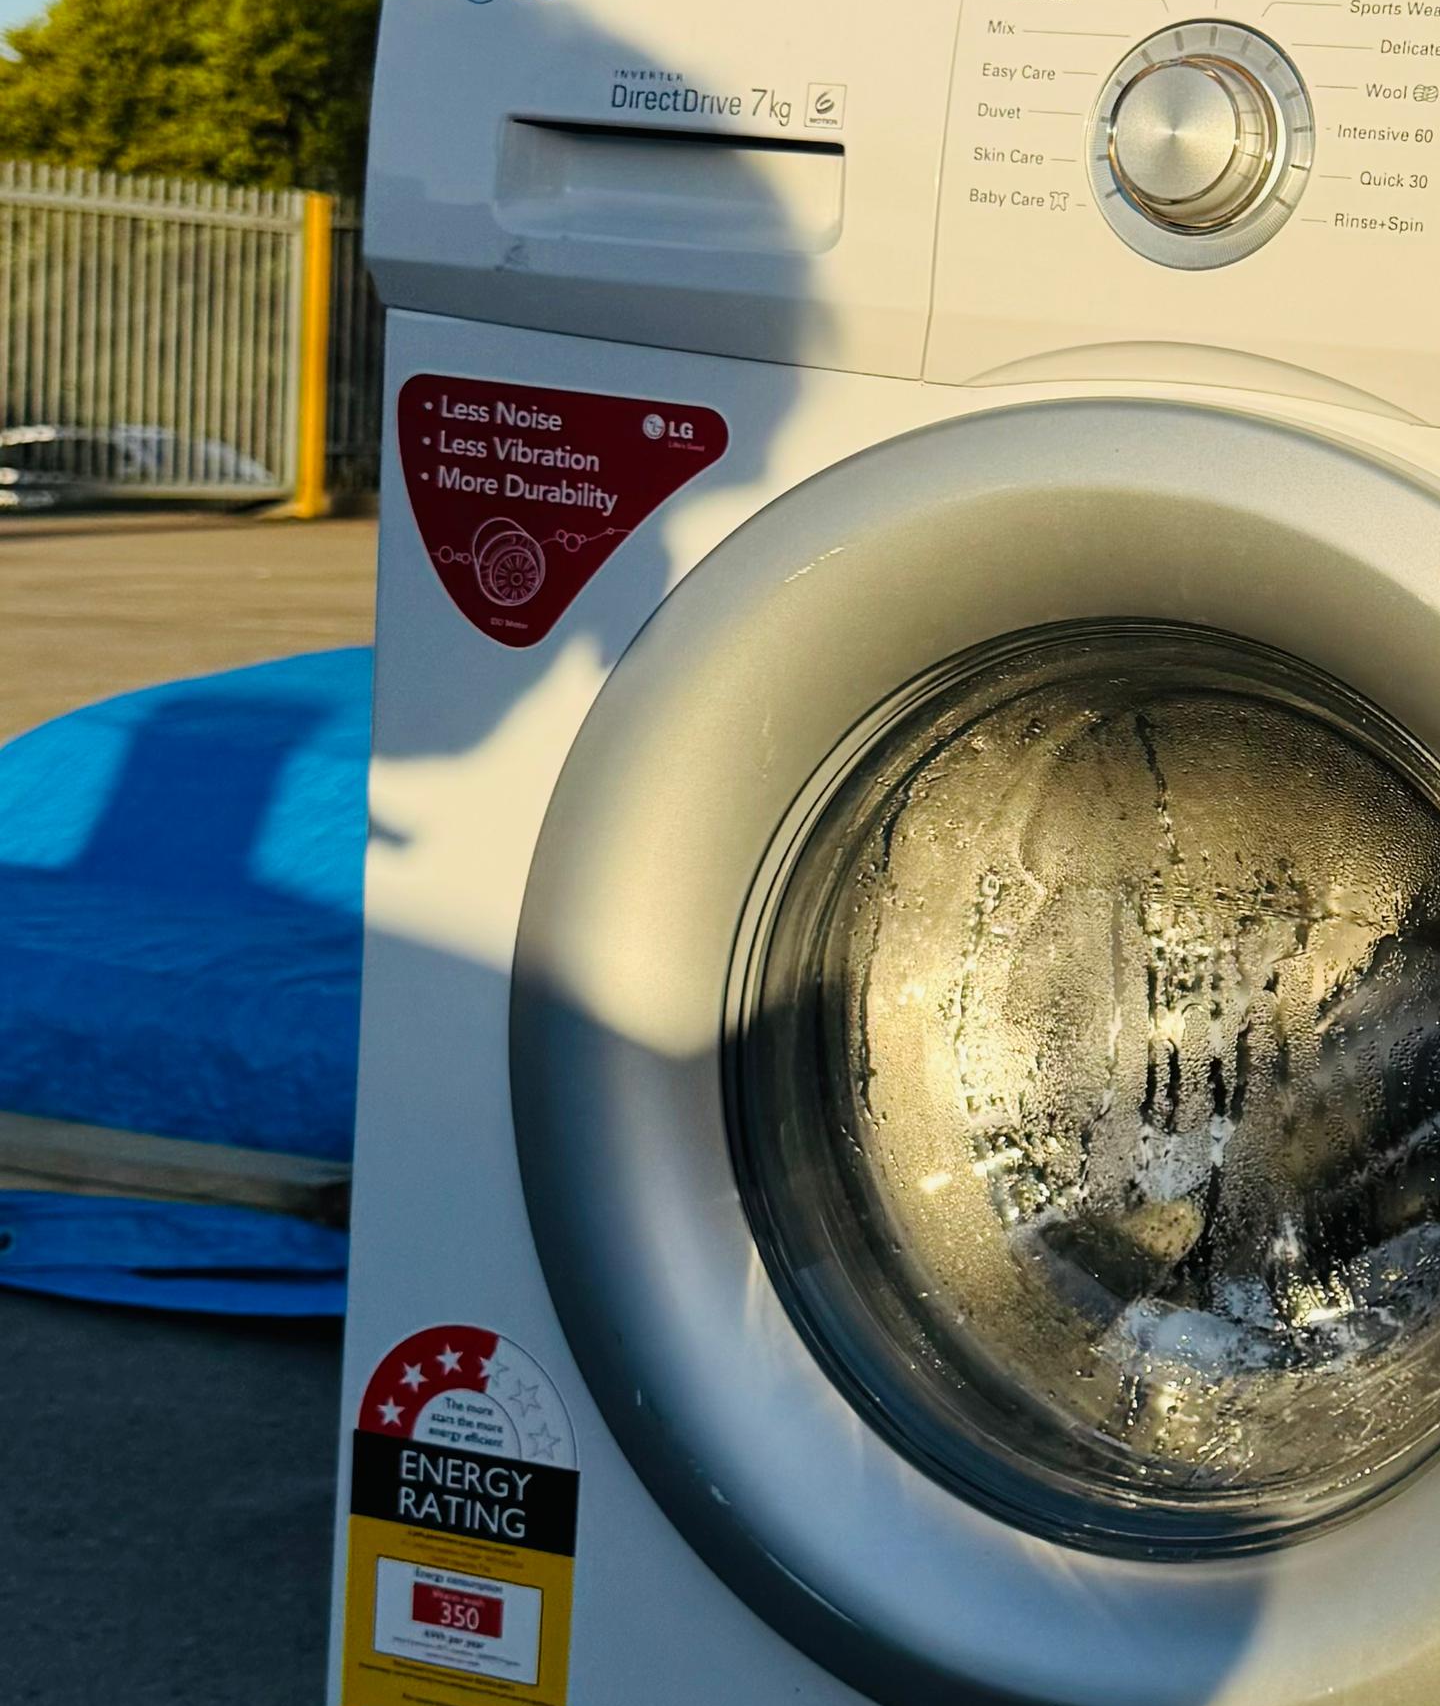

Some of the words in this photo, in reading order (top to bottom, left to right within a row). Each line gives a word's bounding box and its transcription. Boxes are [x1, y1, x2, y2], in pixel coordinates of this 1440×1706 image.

[1350, 0, 1402, 17] Sports
[987, 21, 1015, 35] Mix
[614, 70, 684, 82] INVERTER
[982, 63, 1017, 80] Easy
[1022, 65, 1056, 80] Care
[1366, 83, 1408, 100] Wool
[978, 103, 1021, 119] Duvet
[1338, 124, 1409, 142] Intensive
[1415, 129, 1434, 143] 60
[973, 147, 1005, 163] Skin
[1010, 150, 1044, 165] Care
[1360, 170, 1404, 188] Quick
[1409, 174, 1429, 189] 30
[969, 188, 1005, 208] Baby
[1010, 191, 1045, 206] Care
[1334, 213, 1424, 234] Rinse+Spin
[440, 395, 490, 423] Less
[495, 401, 563, 432] Noise
[668, 421, 694, 440] LG
[439, 430, 488, 458] Less
[493, 436, 600, 472] Vibration
[437, 465, 498, 495] More
[504, 473, 618, 517] Durability
[444, 1396, 464, 1412] The
[401, 1450, 533, 1502] ENERGY
[398, 1487, 526, 1539] RATING
[440, 1603, 480, 1630] 350
